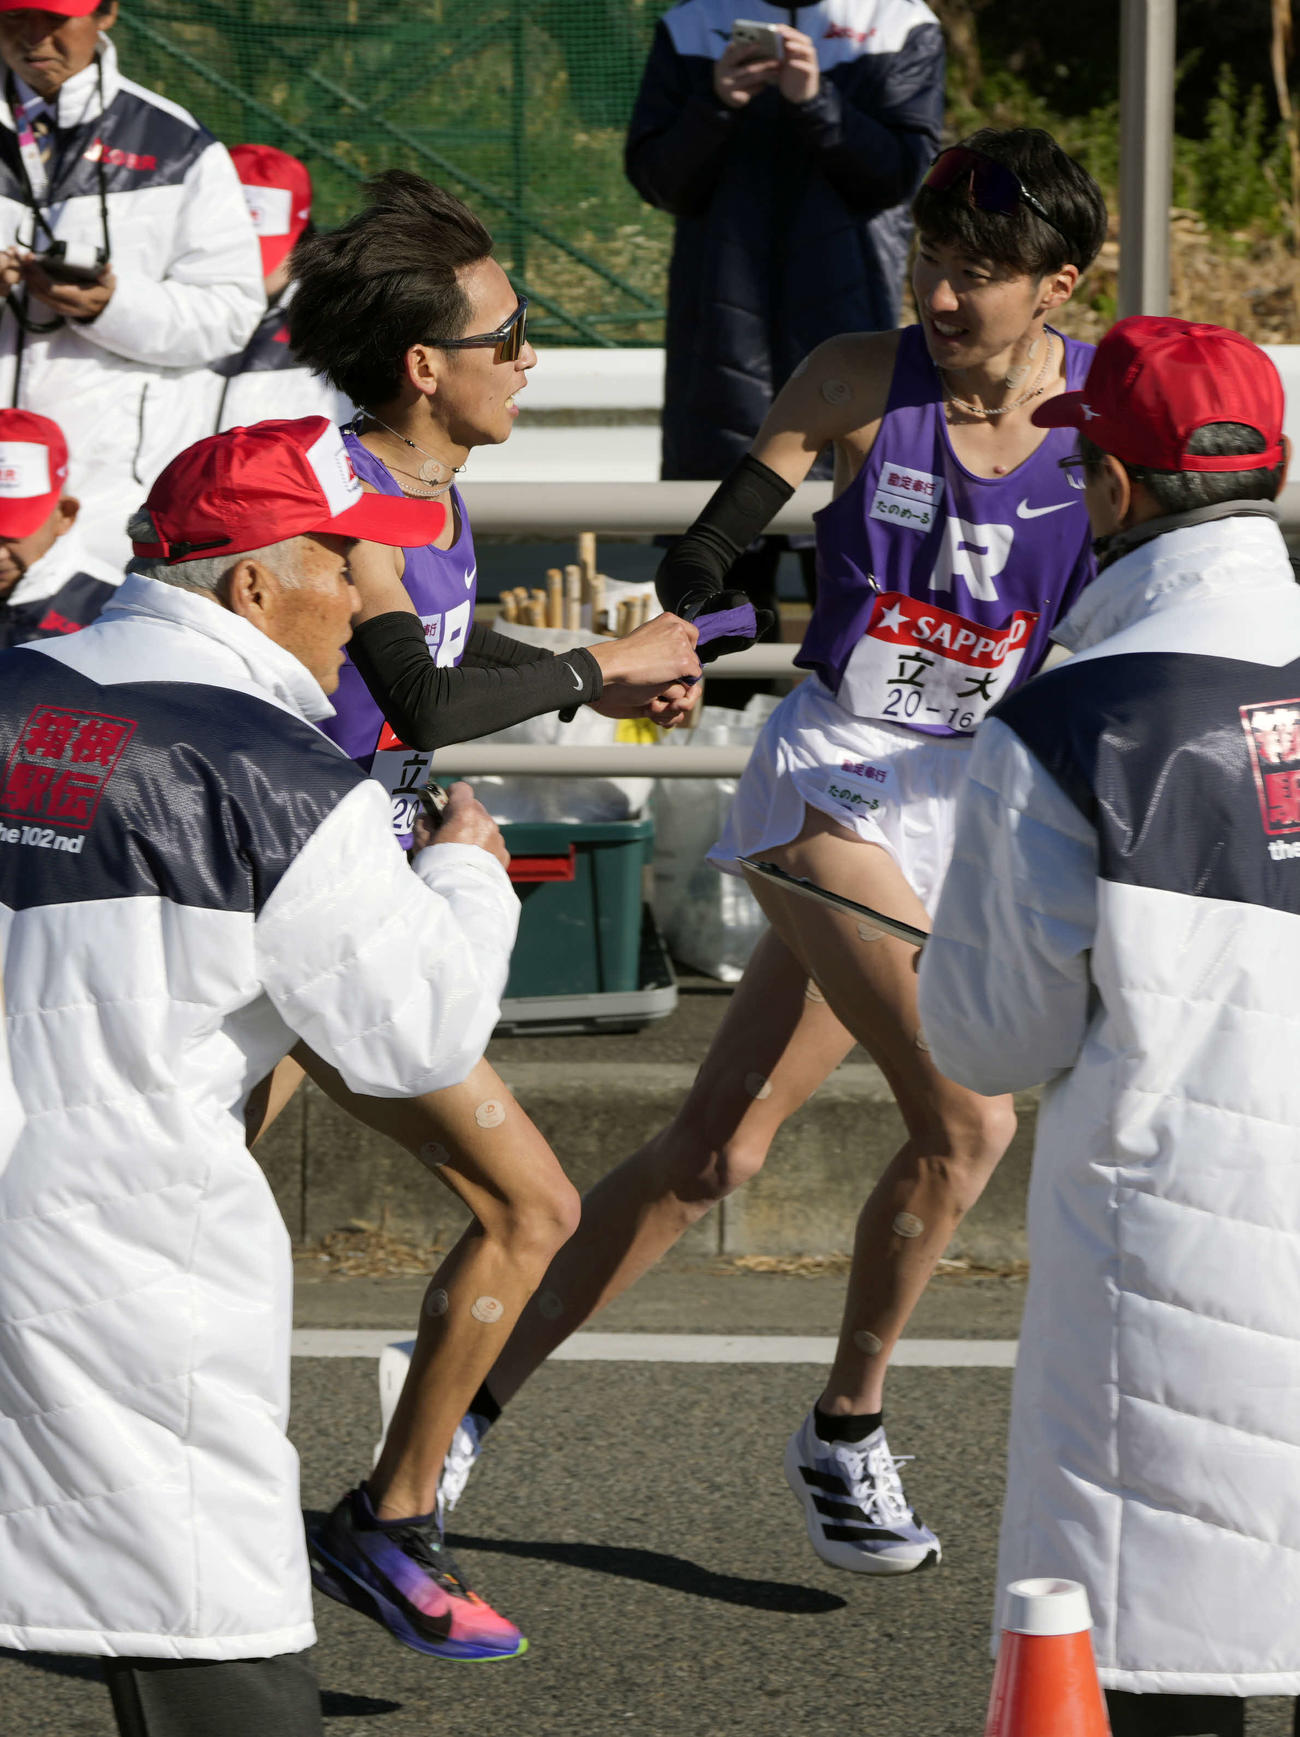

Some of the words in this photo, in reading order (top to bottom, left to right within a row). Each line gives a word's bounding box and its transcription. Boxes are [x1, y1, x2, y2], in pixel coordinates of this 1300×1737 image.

[876, 500, 930, 525] たのめーる
[928, 516, 1014, 602] R
[887, 651, 935, 689] 立
[957, 672, 999, 701] 大
[882, 688, 975, 729] 20-16
[23, 711, 128, 767] 箱根
[2, 762, 100, 820] 駅伝
[391, 753, 429, 795] 立
[828, 784, 880, 810] たのめーる
